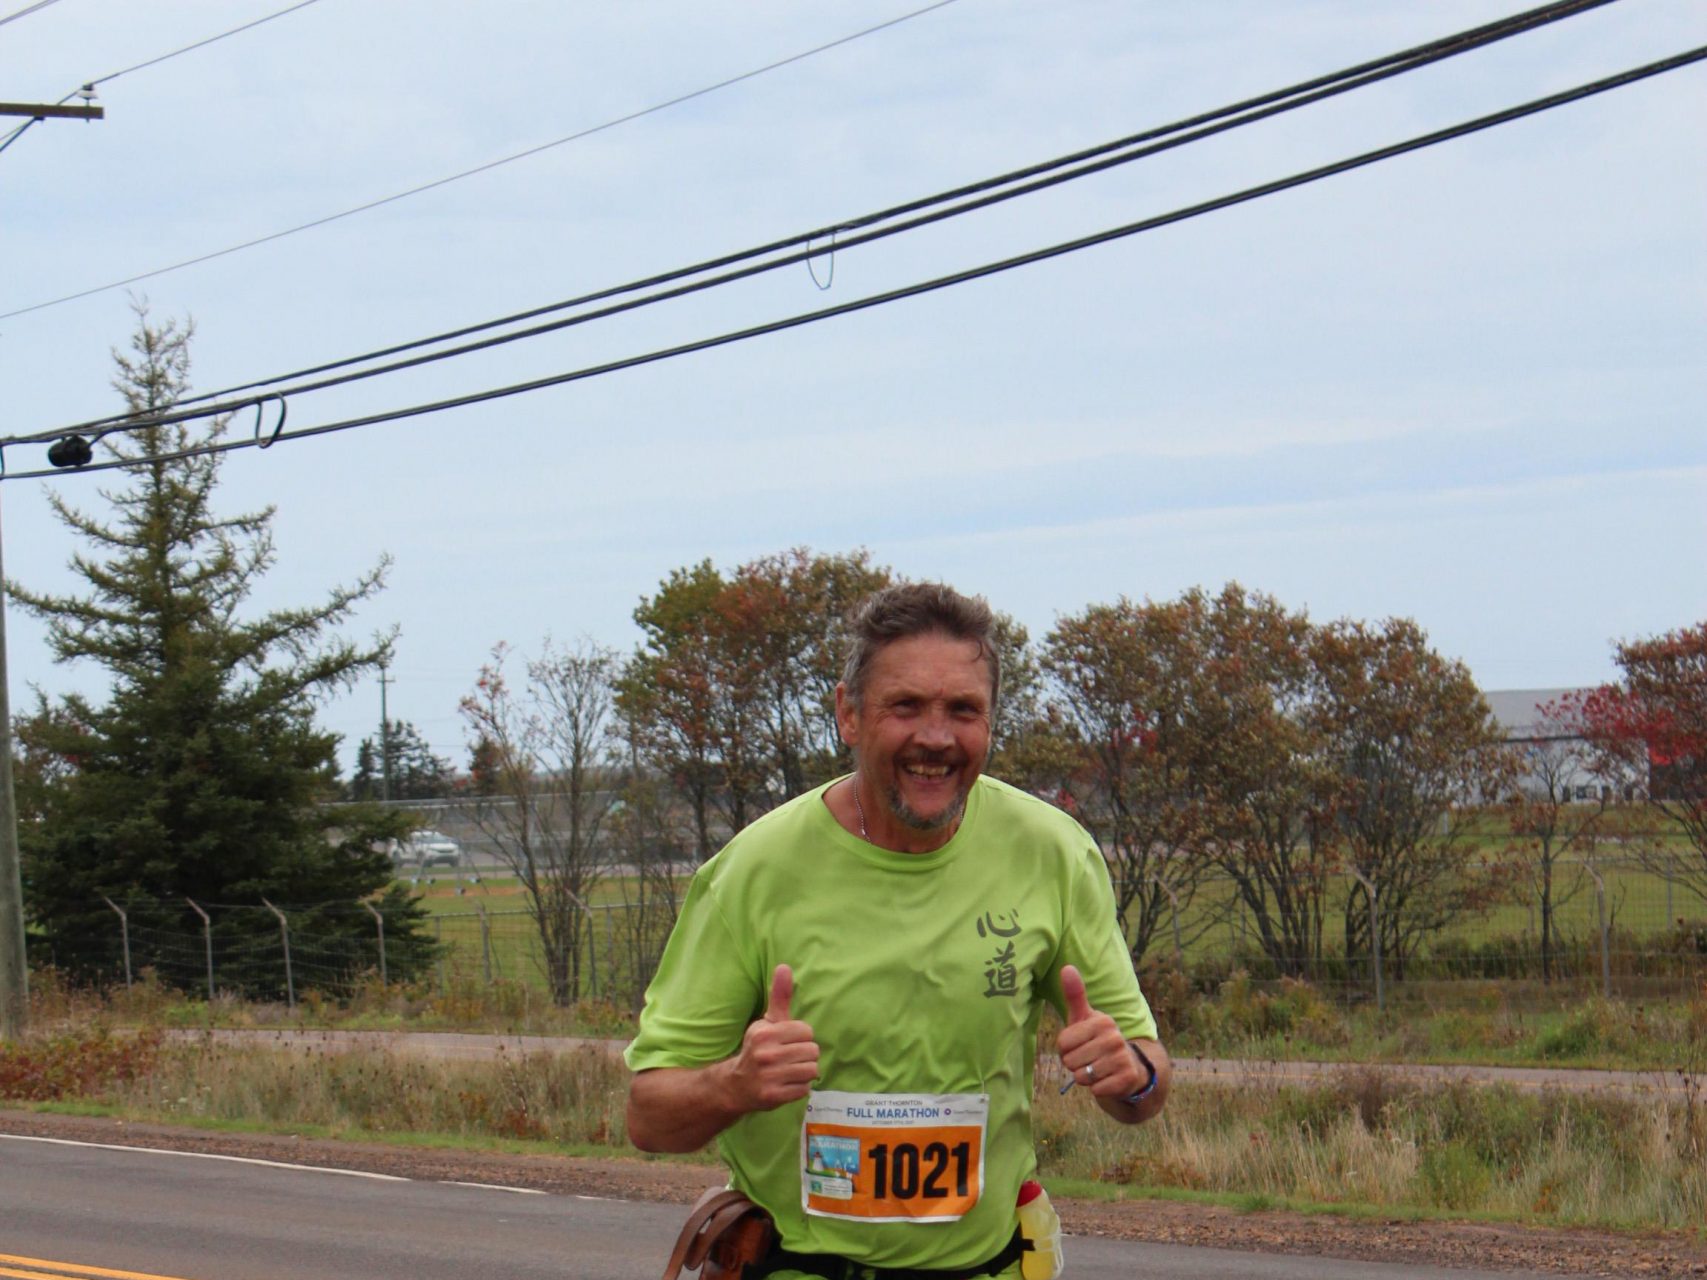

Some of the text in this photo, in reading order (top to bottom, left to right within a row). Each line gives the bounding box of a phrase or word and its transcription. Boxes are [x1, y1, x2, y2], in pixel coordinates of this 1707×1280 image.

[977, 908, 1021, 998] 心道
[847, 1107, 873, 1118] FULL
[876, 1107, 939, 1119] MARATHON
[868, 1141, 970, 1200] 1021
